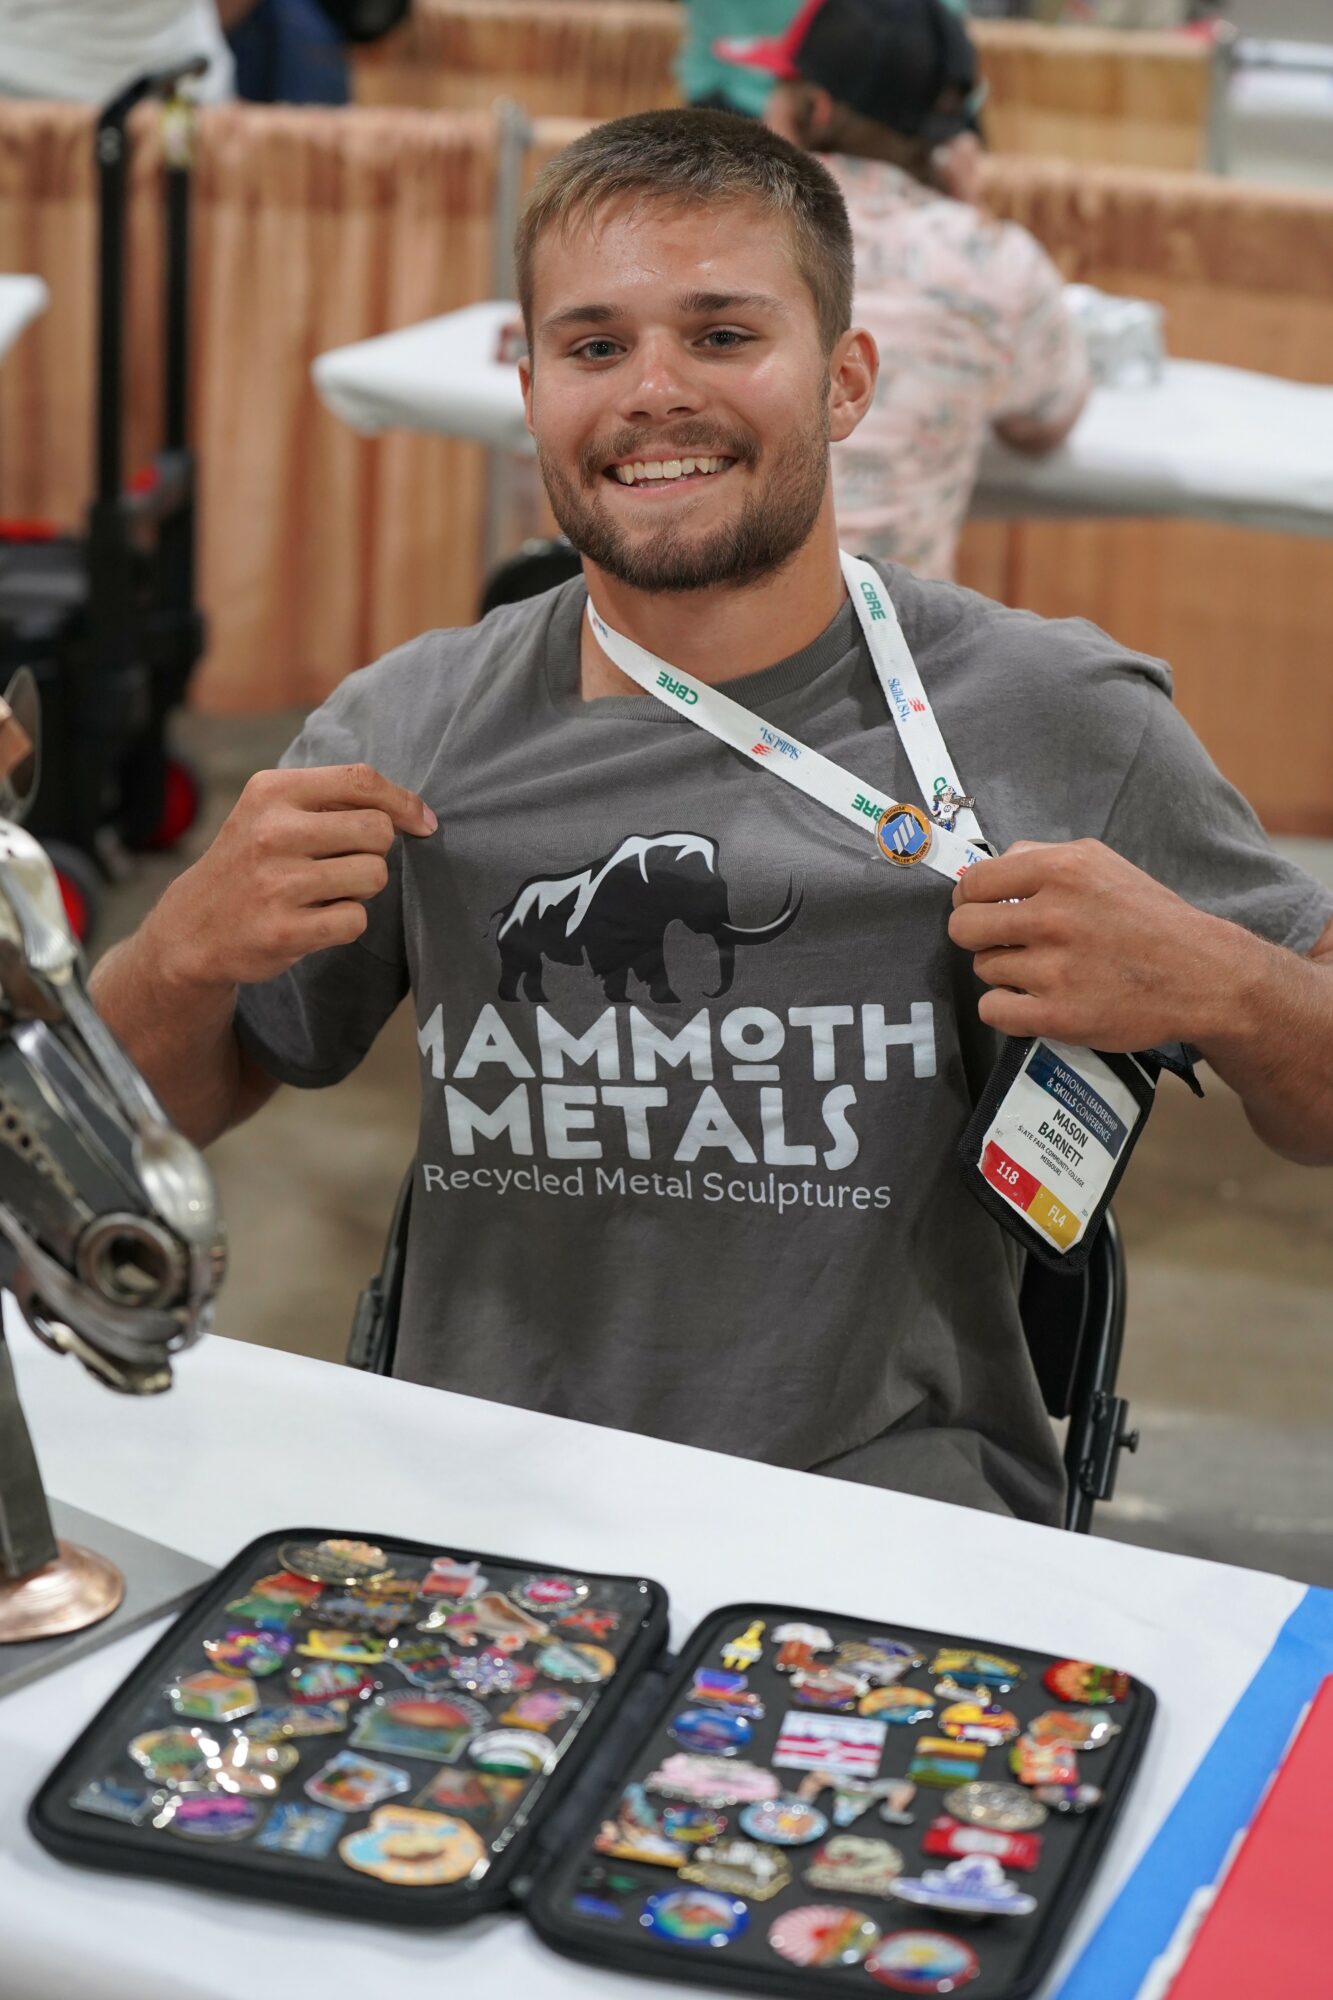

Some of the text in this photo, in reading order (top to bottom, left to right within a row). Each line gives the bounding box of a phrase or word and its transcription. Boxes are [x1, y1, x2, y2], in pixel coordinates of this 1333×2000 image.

[860, 581, 887, 621] CBRE
[655, 671, 699, 706] CBRE
[760, 727, 802, 761] SkillsUSA
[851, 793, 885, 822] BRE
[416, 1001, 937, 1082] MAMMOTH
[1046, 1077, 1111, 1143] & SKILLS CONFERENCE
[1053, 1065, 1118, 1131] NATIONAL LEADERSHIP
[444, 1082, 860, 1171] METALS
[1037, 1121, 1084, 1168] BARNETT
[1052, 1108, 1089, 1148] MASON
[996, 1161, 1020, 1185] 118
[1032, 1137, 1046, 1151] FAIR
[1045, 1147, 1069, 1172] COMMUNITY
[1067, 1169, 1085, 1188] COLLEGE
[1040, 1154, 1062, 1176] MISSOURI
[422, 1163, 892, 1214] Recycled Metal Sculptures
[1047, 1204, 1067, 1228] FL4
